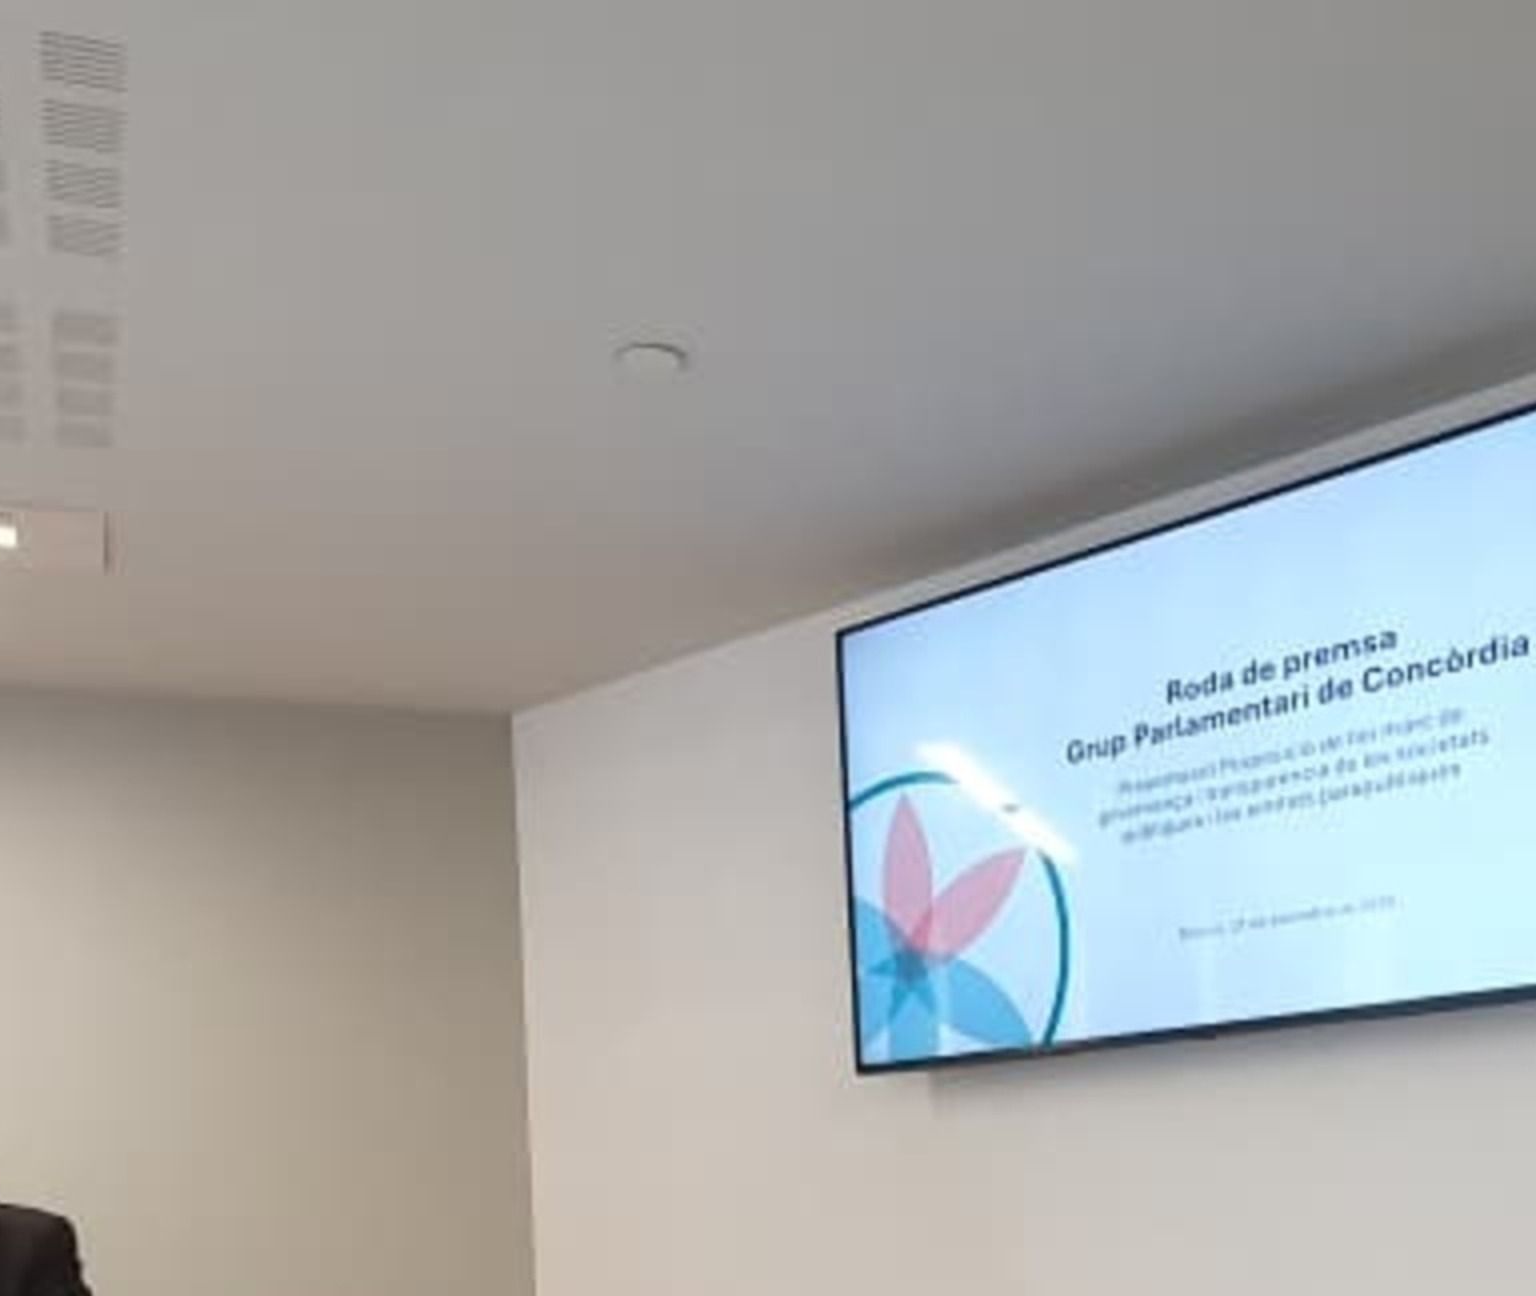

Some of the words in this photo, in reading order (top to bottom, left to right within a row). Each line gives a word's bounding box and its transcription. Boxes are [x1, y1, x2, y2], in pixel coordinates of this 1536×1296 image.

[1066, 734, 1127, 764] Grup
[1134, 683, 1310, 746] Parlamentari
[1318, 677, 1353, 704] de
[1362, 634, 1530, 692] Concòrdia
[1166, 671, 1234, 704] Roda
[1242, 658, 1276, 686] de
[1282, 630, 1397, 680] premsa
